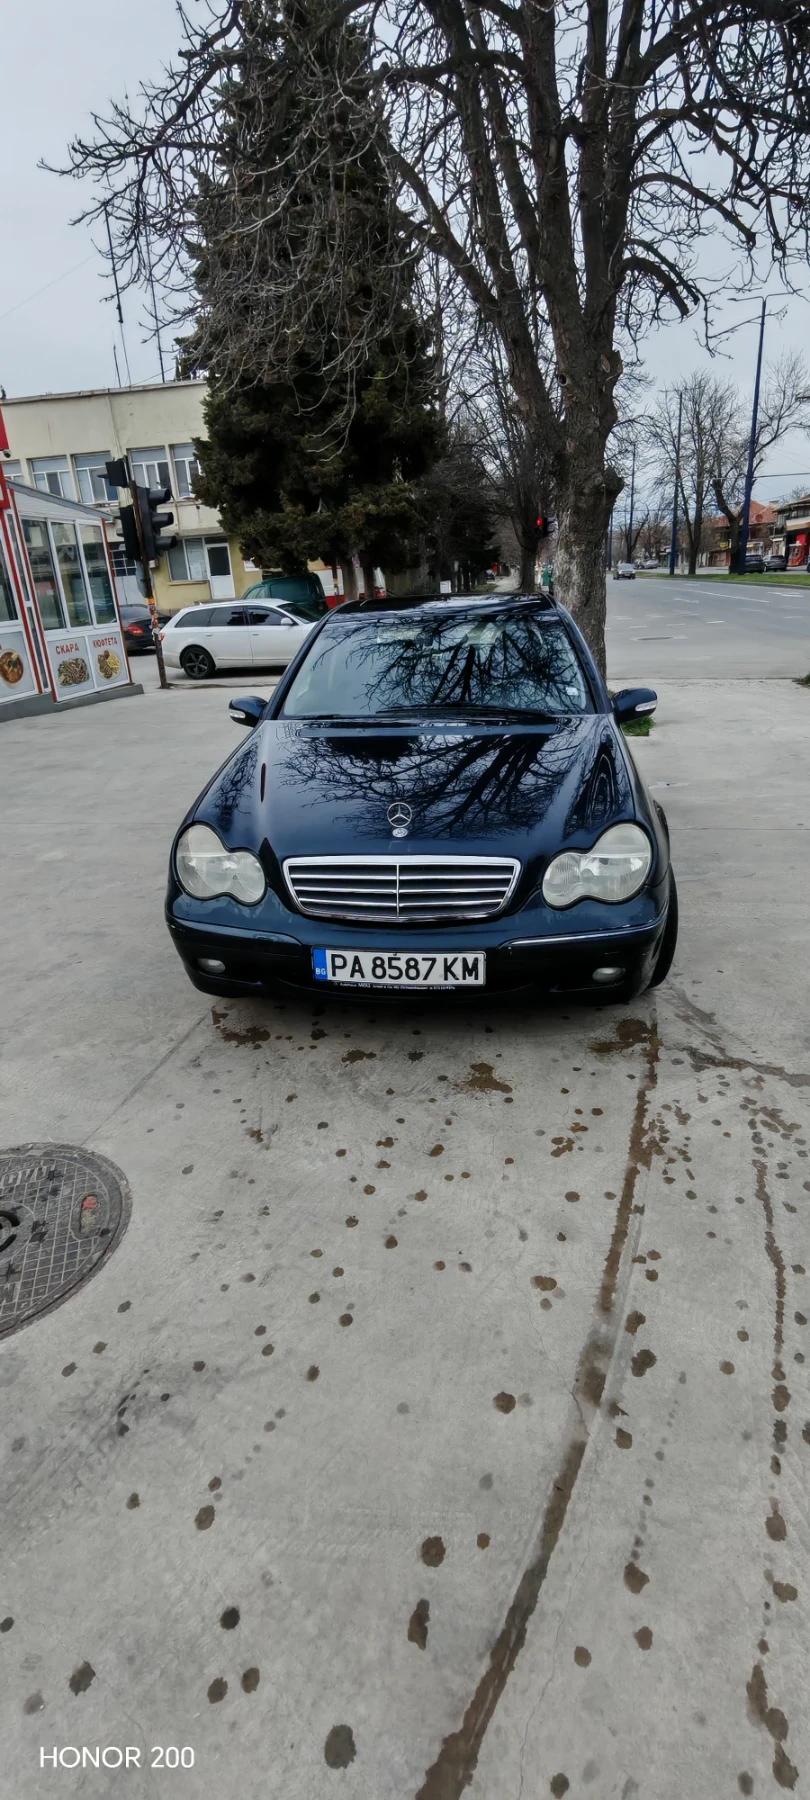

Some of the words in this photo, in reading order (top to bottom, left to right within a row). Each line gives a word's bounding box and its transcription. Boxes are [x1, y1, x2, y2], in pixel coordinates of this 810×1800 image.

[92, 637, 118, 648] КЮФТЕТА
[55, 643, 80, 655] СКАРА
[315, 967, 326, 976] BG
[331, 953, 365, 979] PA
[371, 955, 438, 981] 8587
[443, 956, 479, 981] KM
